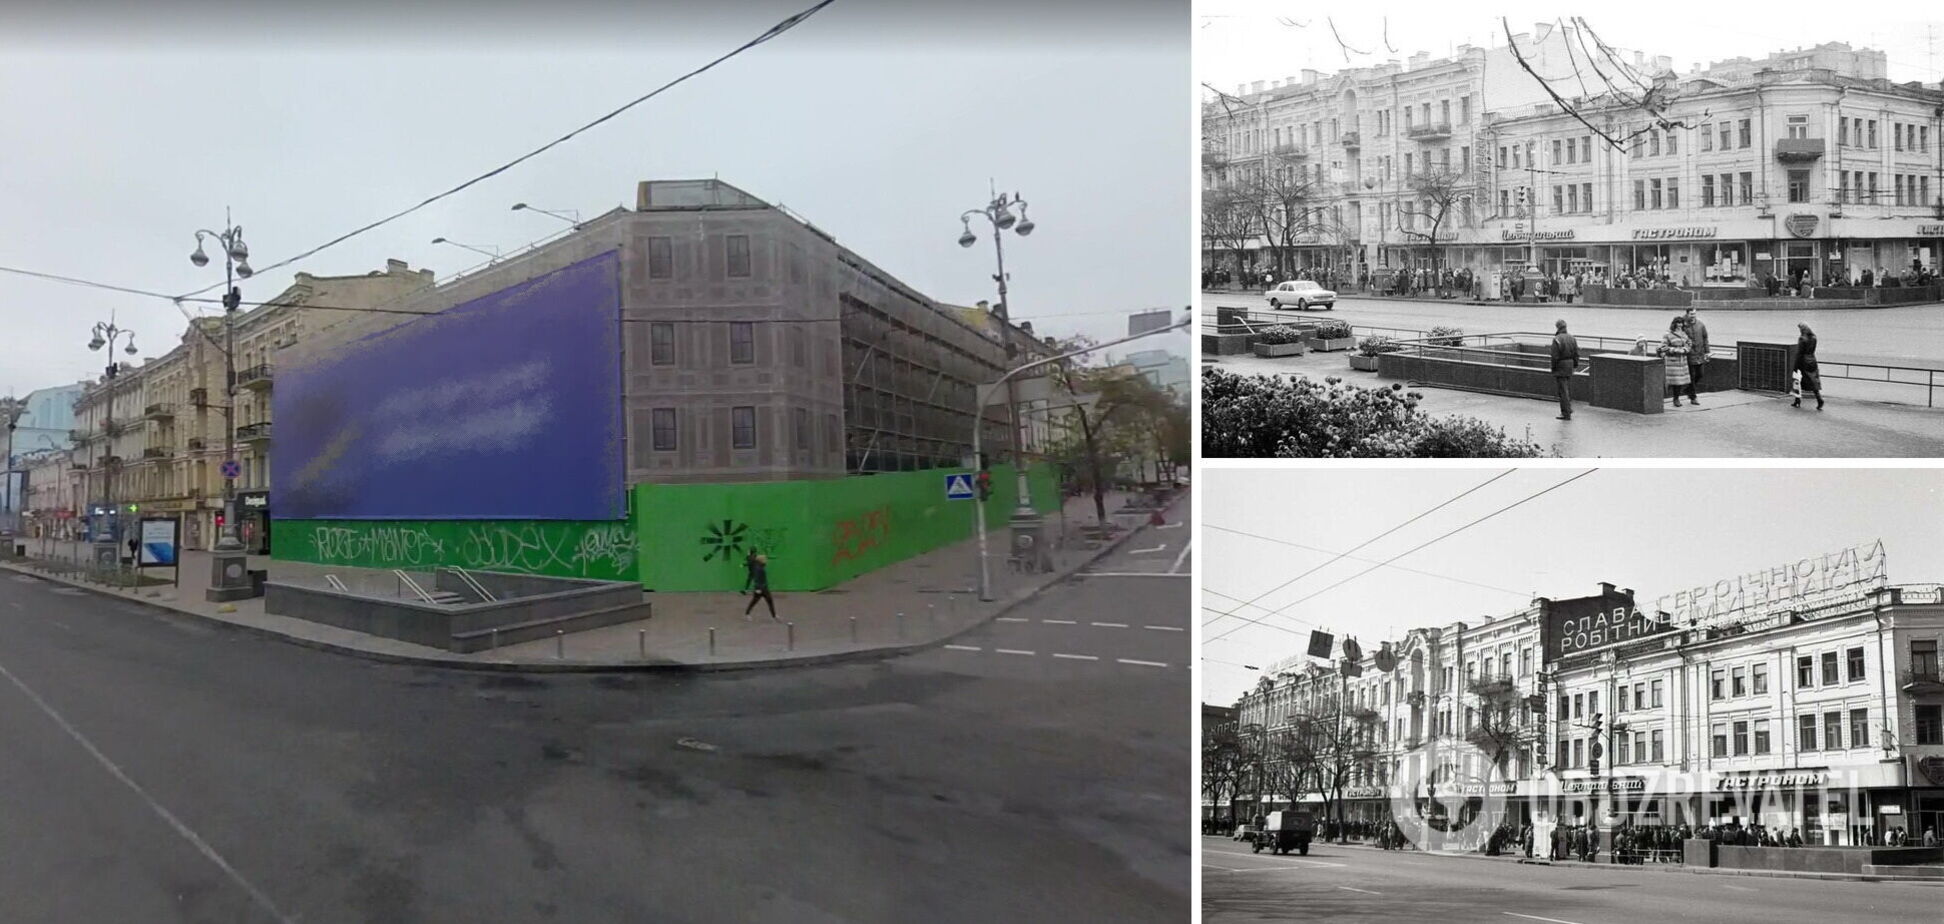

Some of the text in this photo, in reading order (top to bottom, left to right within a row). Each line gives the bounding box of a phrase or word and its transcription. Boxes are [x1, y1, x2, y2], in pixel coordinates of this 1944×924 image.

[1632, 225, 1717, 240] ГАСТРОНОМ
[1563, 603, 1646, 636] СЛАВА
[1716, 774, 1828, 791] ГАСТРОНОМ
